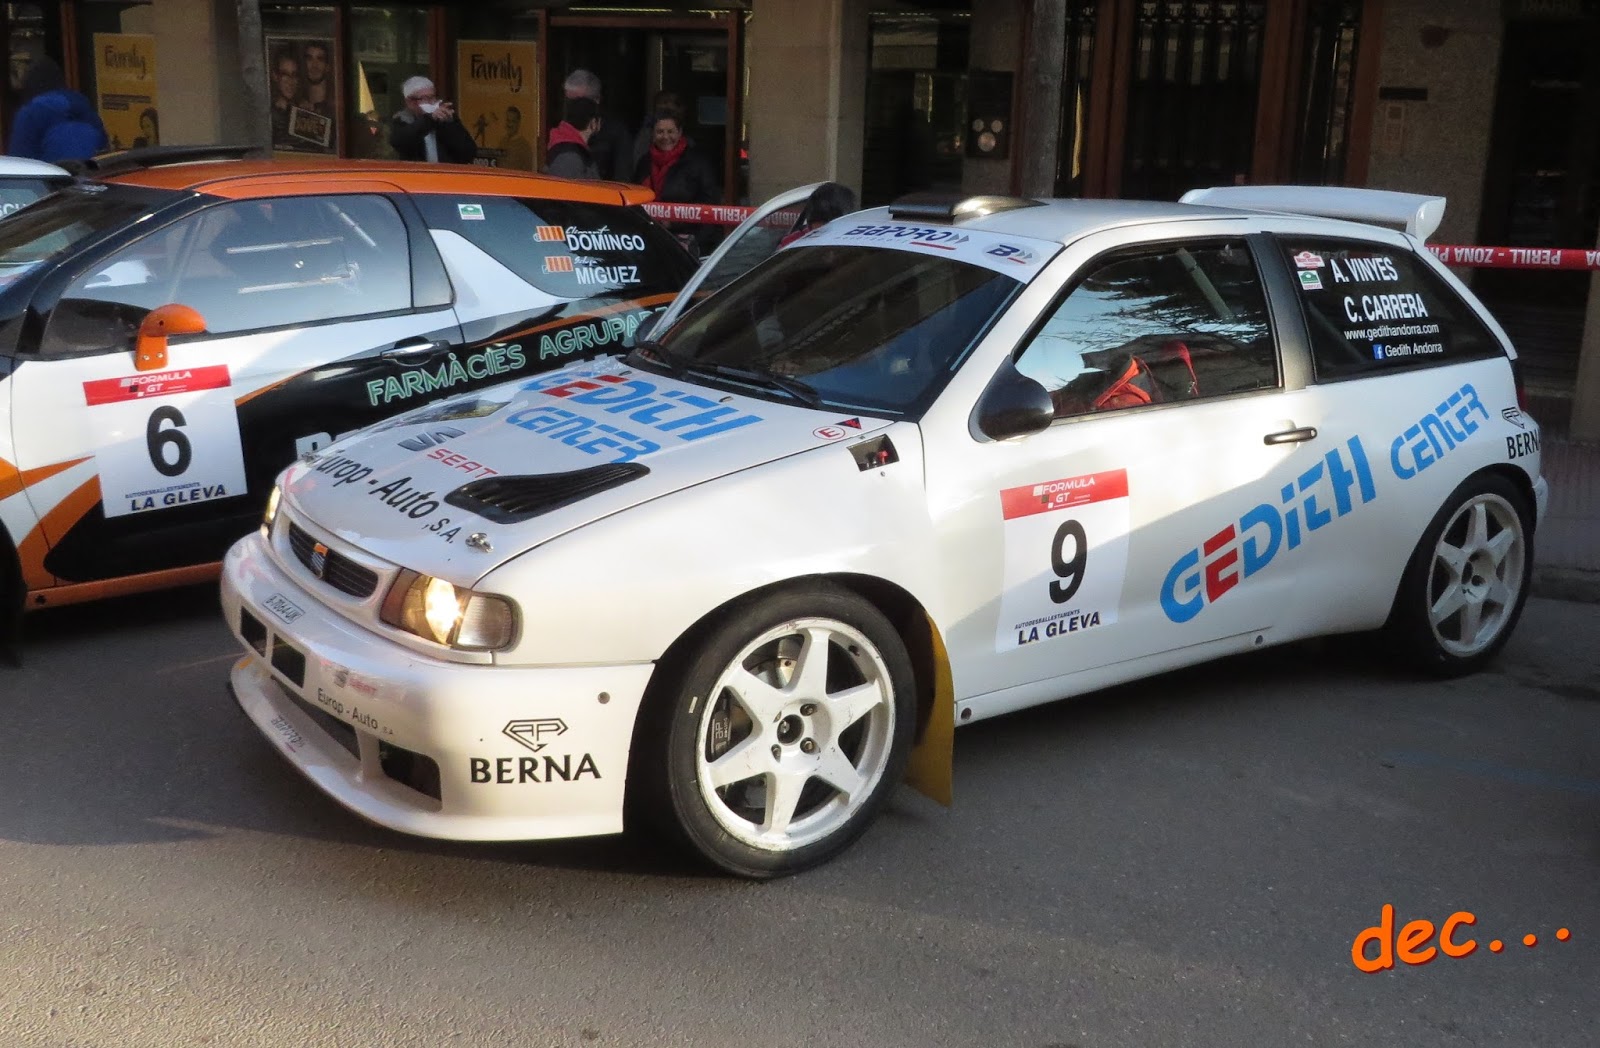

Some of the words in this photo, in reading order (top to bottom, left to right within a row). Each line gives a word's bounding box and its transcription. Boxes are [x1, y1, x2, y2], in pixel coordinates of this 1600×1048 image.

[471, 52, 523, 94] Family
[674, 205, 702, 220] ZONA
[712, 207, 748, 222] PERILL
[566, 234, 645, 251] DOMINGO
[1454, 247, 1494, 263] ZONA
[1509, 249, 1562, 265] PERILL
[575, 265, 641, 285] MIGUEZ
[1330, 258, 1350, 283] A.
[1346, 256, 1398, 283] VINYES
[1344, 296, 1362, 323] C.
[1362, 293, 1429, 322] CARRERA
[540, 306, 669, 360] AGRUPA
[1344, 323, 1440, 341] www.gedithandorra.com
[1384, 344, 1412, 357] Gedith
[1412, 342, 1443, 354] Andorra
[131, 370, 192, 386] FORMULA
[146, 383, 163, 392] GT
[146, 405, 192, 477] 6
[1506, 429, 1541, 460] BERN
[427, 448, 499, 479] SEAT
[131, 497, 155, 511] LA
[163, 484, 226, 506] GLEVA
[368, 476, 440, 519] Auto
[1042, 477, 1095, 495] FORMULA
[1056, 493, 1070, 503] GT
[1049, 519, 1088, 604] 9
[1014, 609, 1081, 630] AUTODESBALLESTAMENTS
[1018, 627, 1040, 646] LA
[1046, 611, 1101, 638] GLEVA
[317, 687, 344, 715] Europ
[352, 706, 379, 730] Auto
[469, 753, 602, 784] BERNA
